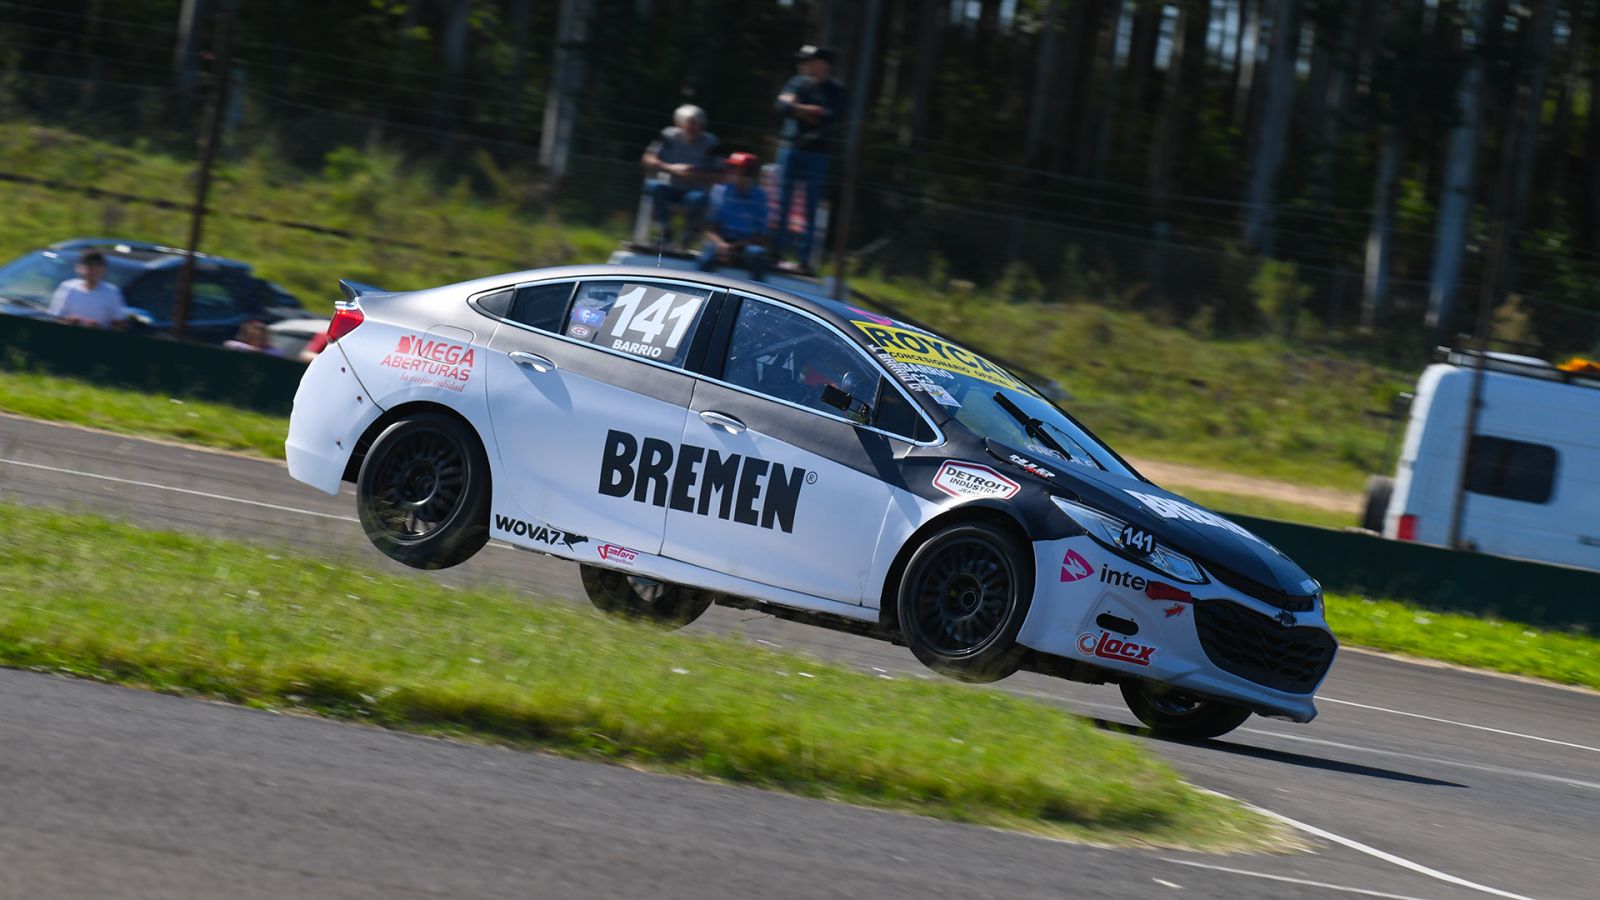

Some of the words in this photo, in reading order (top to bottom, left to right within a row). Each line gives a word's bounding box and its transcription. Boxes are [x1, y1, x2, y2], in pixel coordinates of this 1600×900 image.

[611, 286, 703, 349] 141
[411, 338, 475, 368] MEGA
[611, 339, 662, 358] BARRIO
[380, 354, 472, 382] ABERTURAS
[877, 353, 915, 382] BARRIO
[889, 351, 972, 374] CONCESIONARIO
[945, 467, 1012, 492] DETROIT
[949, 477, 998, 494] INDUSTRY
[495, 513, 561, 545] WOVA7
[1123, 527, 1154, 552] 141
